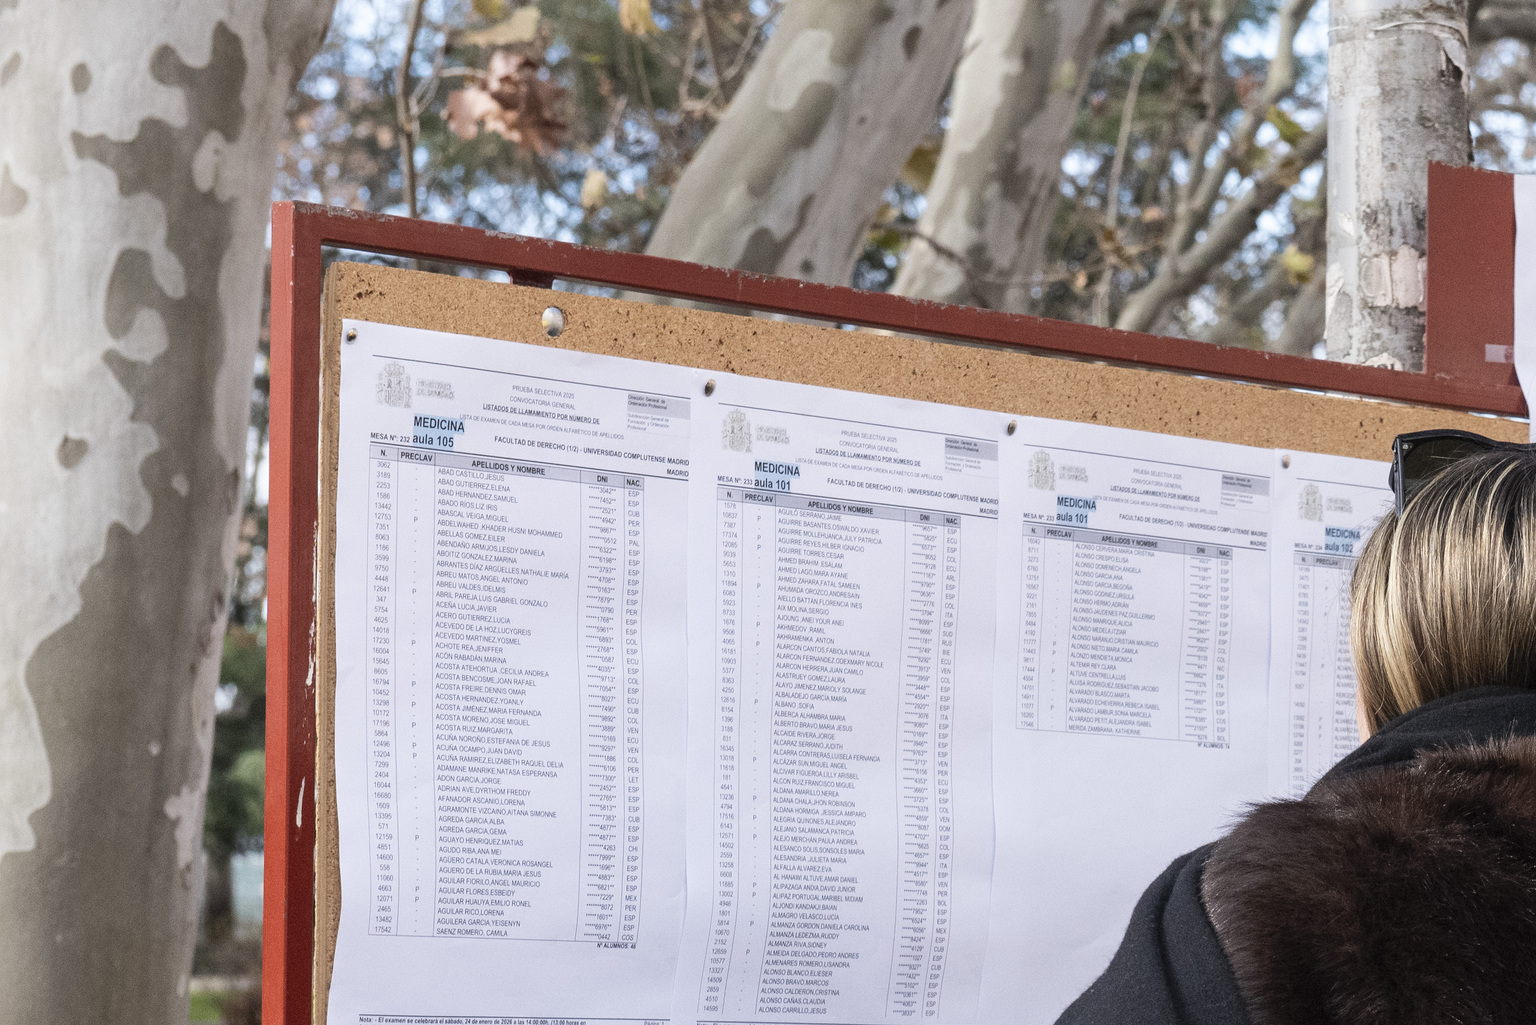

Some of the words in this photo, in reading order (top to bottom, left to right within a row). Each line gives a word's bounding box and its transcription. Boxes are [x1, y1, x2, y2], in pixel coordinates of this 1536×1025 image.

[512, 385, 533, 394] PRUEBA
[535, 388, 562, 397] SELECTIVA
[510, 396, 551, 407] CONVOCATORIA
[553, 401, 575, 410] GENERAL
[483, 404, 509, 413] LISTADOS
[519, 408, 556, 419] LLAMAMIENTO
[570, 414, 591, 423] NÚMERO
[414, 416, 464, 432] MEDICINA
[371, 432, 388, 440] MESA
[413, 434, 433, 445] aula
[438, 436, 453, 447] 105
[401, 452, 432, 462] PRECLAV
[495, 436, 526, 446] FACULTAD
[537, 441, 566, 451] DERECHO
[584, 446, 622, 457] UNIVERSIDAD
[624, 451, 665, 462] COMPLUTENSE
[667, 456, 689, 465] MADRID
[472, 460, 508, 471] APELLIDOS
[517, 466, 545, 475] NOMBRE
[755, 461, 800, 476] MEDICINA
[754, 479, 772, 489] aula
[776, 480, 790, 490] 101
[827, 478, 856, 488] FACULTAD
[866, 483, 891, 492] DERECHO
[908, 488, 941, 498] UNIVERSIDAD
[943, 492, 979, 502] COMPLUTENSE
[980, 496, 998, 504] MADRID
[745, 494, 773, 503] PRECLAV
[1057, 497, 1096, 511] MEDICINA
[808, 501, 841, 512] APELLIDOS
[848, 505, 873, 515] NOMBRE
[1057, 513, 1073, 523] aula
[1075, 514, 1088, 524] 101
[1326, 528, 1360, 539] MEDICINA
[1102, 536, 1130, 545] APELLIDOS
[1137, 539, 1158, 548] NOMBRE
[1325, 543, 1340, 551] aula
[1342, 544, 1353, 552] 102
